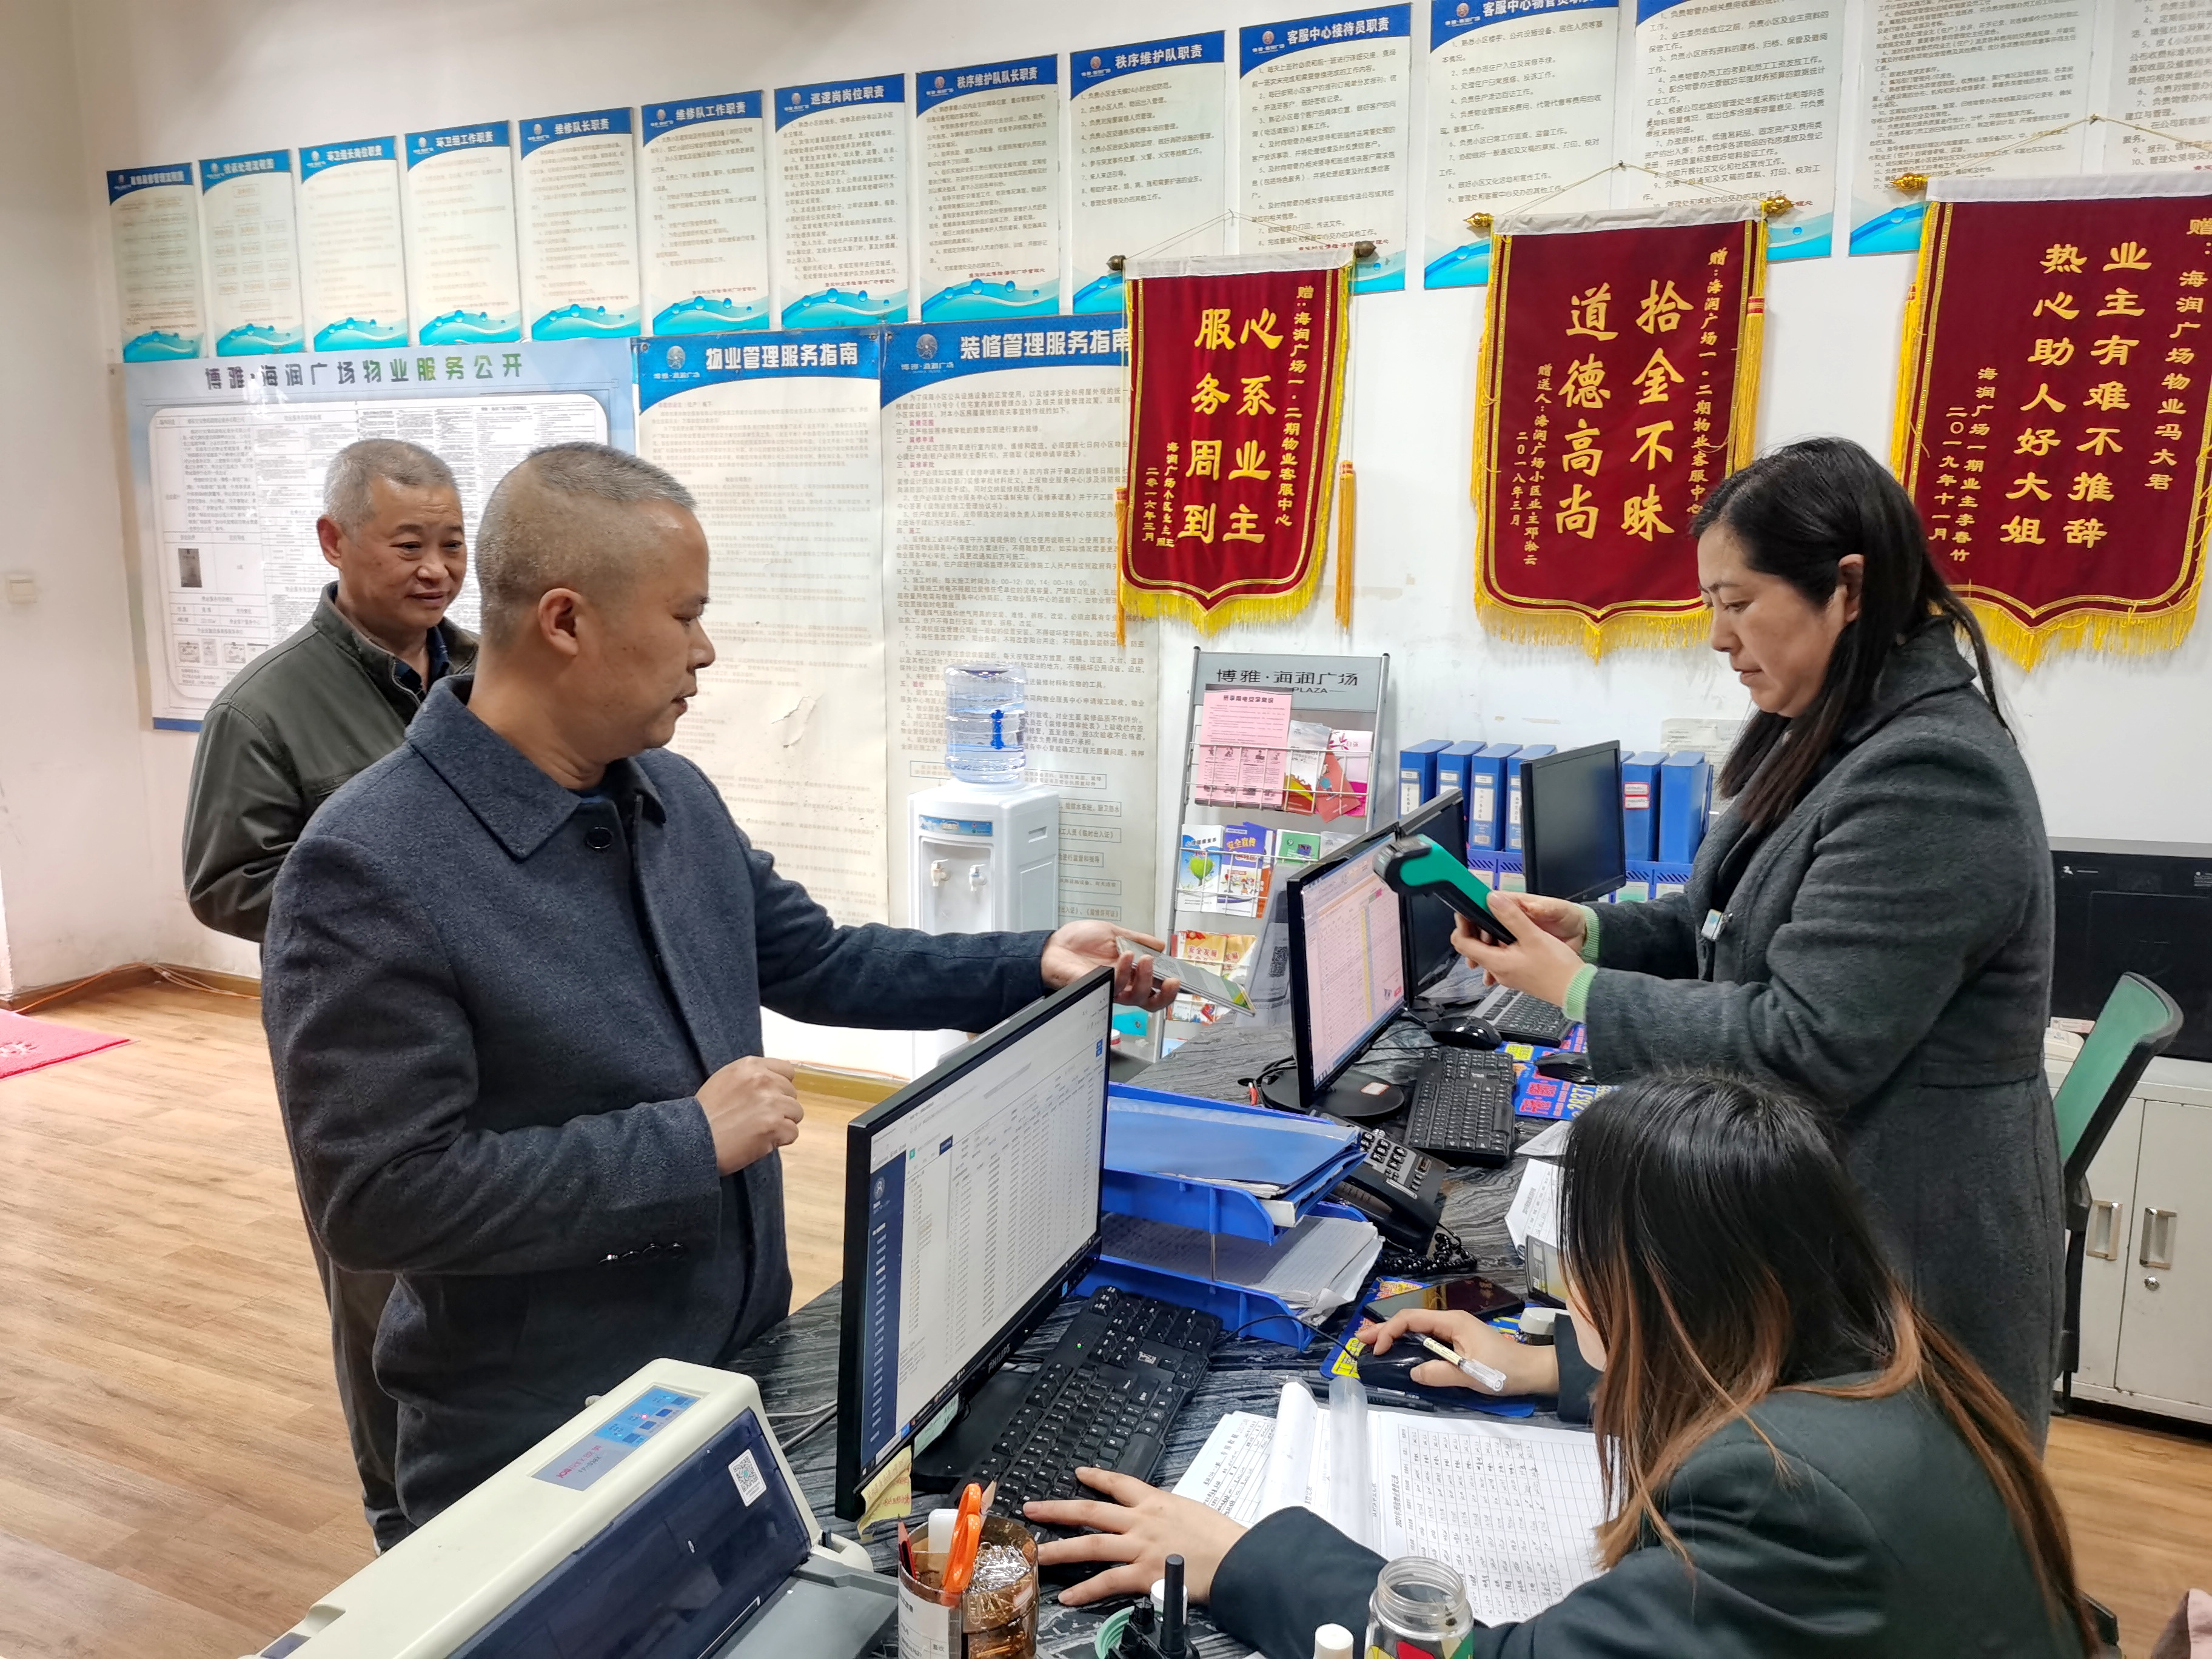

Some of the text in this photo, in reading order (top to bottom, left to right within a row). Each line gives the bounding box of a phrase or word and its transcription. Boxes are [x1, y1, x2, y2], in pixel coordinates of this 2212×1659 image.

[1287, 17, 1389, 45] 客服中心接待员职责
[1115, 45, 1202, 69] 秩序维护队职责
[957, 67, 1038, 90] 秩序维护队队长职责
[811, 85, 884, 106] 巡逻岗岗位职责
[675, 101, 746, 120] 维修队工作职责
[436, 132, 493, 148] 环卫组工作职责
[555, 119, 609, 135] 维修队长职责
[706, 342, 858, 370] 物业管理服务指南
[960, 327, 1129, 360] 装修管理服务指南
[205, 354, 521, 390] 博雅·海润广场物业服务公开
[2000, 243, 2088, 545] 热心助人好大姐
[2062, 241, 2153, 549] 业主有难不推辞
[1555, 283, 1618, 540] 道德高尚
[1621, 279, 1694, 542] 拾金不昧
[1178, 308, 1236, 544] 服务周到
[1222, 308, 1284, 543] 心系业主
[1950, 367, 1999, 562] 海润广场一期业主李春竹
[1142, 467, 1159, 541] 二零一六年三月
[1217, 669, 1358, 686] 博雅·海润广场
[1226, 837, 1257, 850] 安全宣传
[1188, 945, 1218, 957] 安全发展
